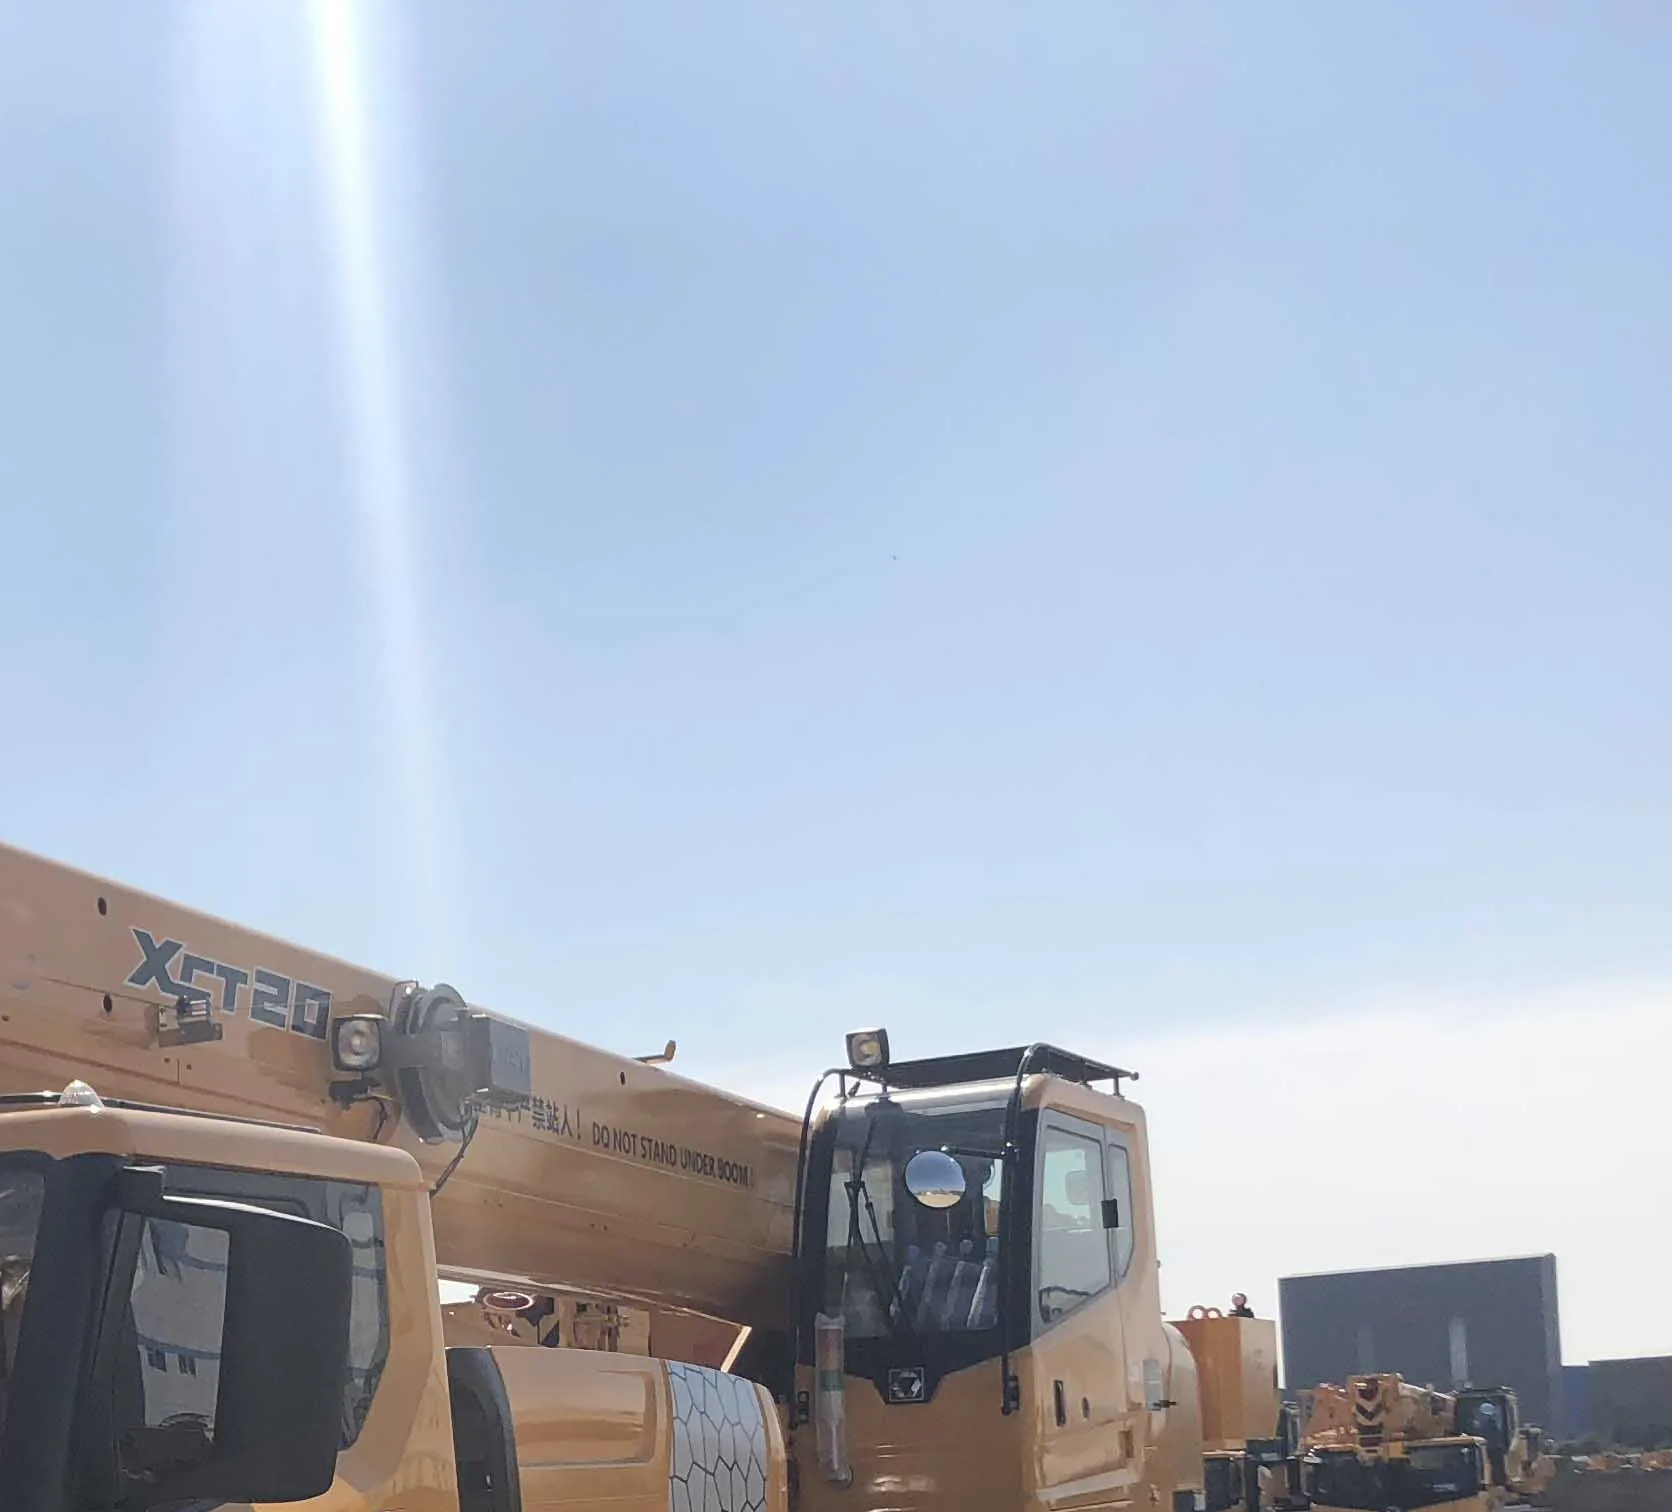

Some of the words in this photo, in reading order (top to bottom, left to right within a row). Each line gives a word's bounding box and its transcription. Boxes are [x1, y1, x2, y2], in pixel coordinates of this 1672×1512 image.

[592, 1121, 610, 1149] DO
[613, 1127, 637, 1157] NOT
[640, 1136, 677, 1168] STAND
[680, 1149, 716, 1179] UNDER
